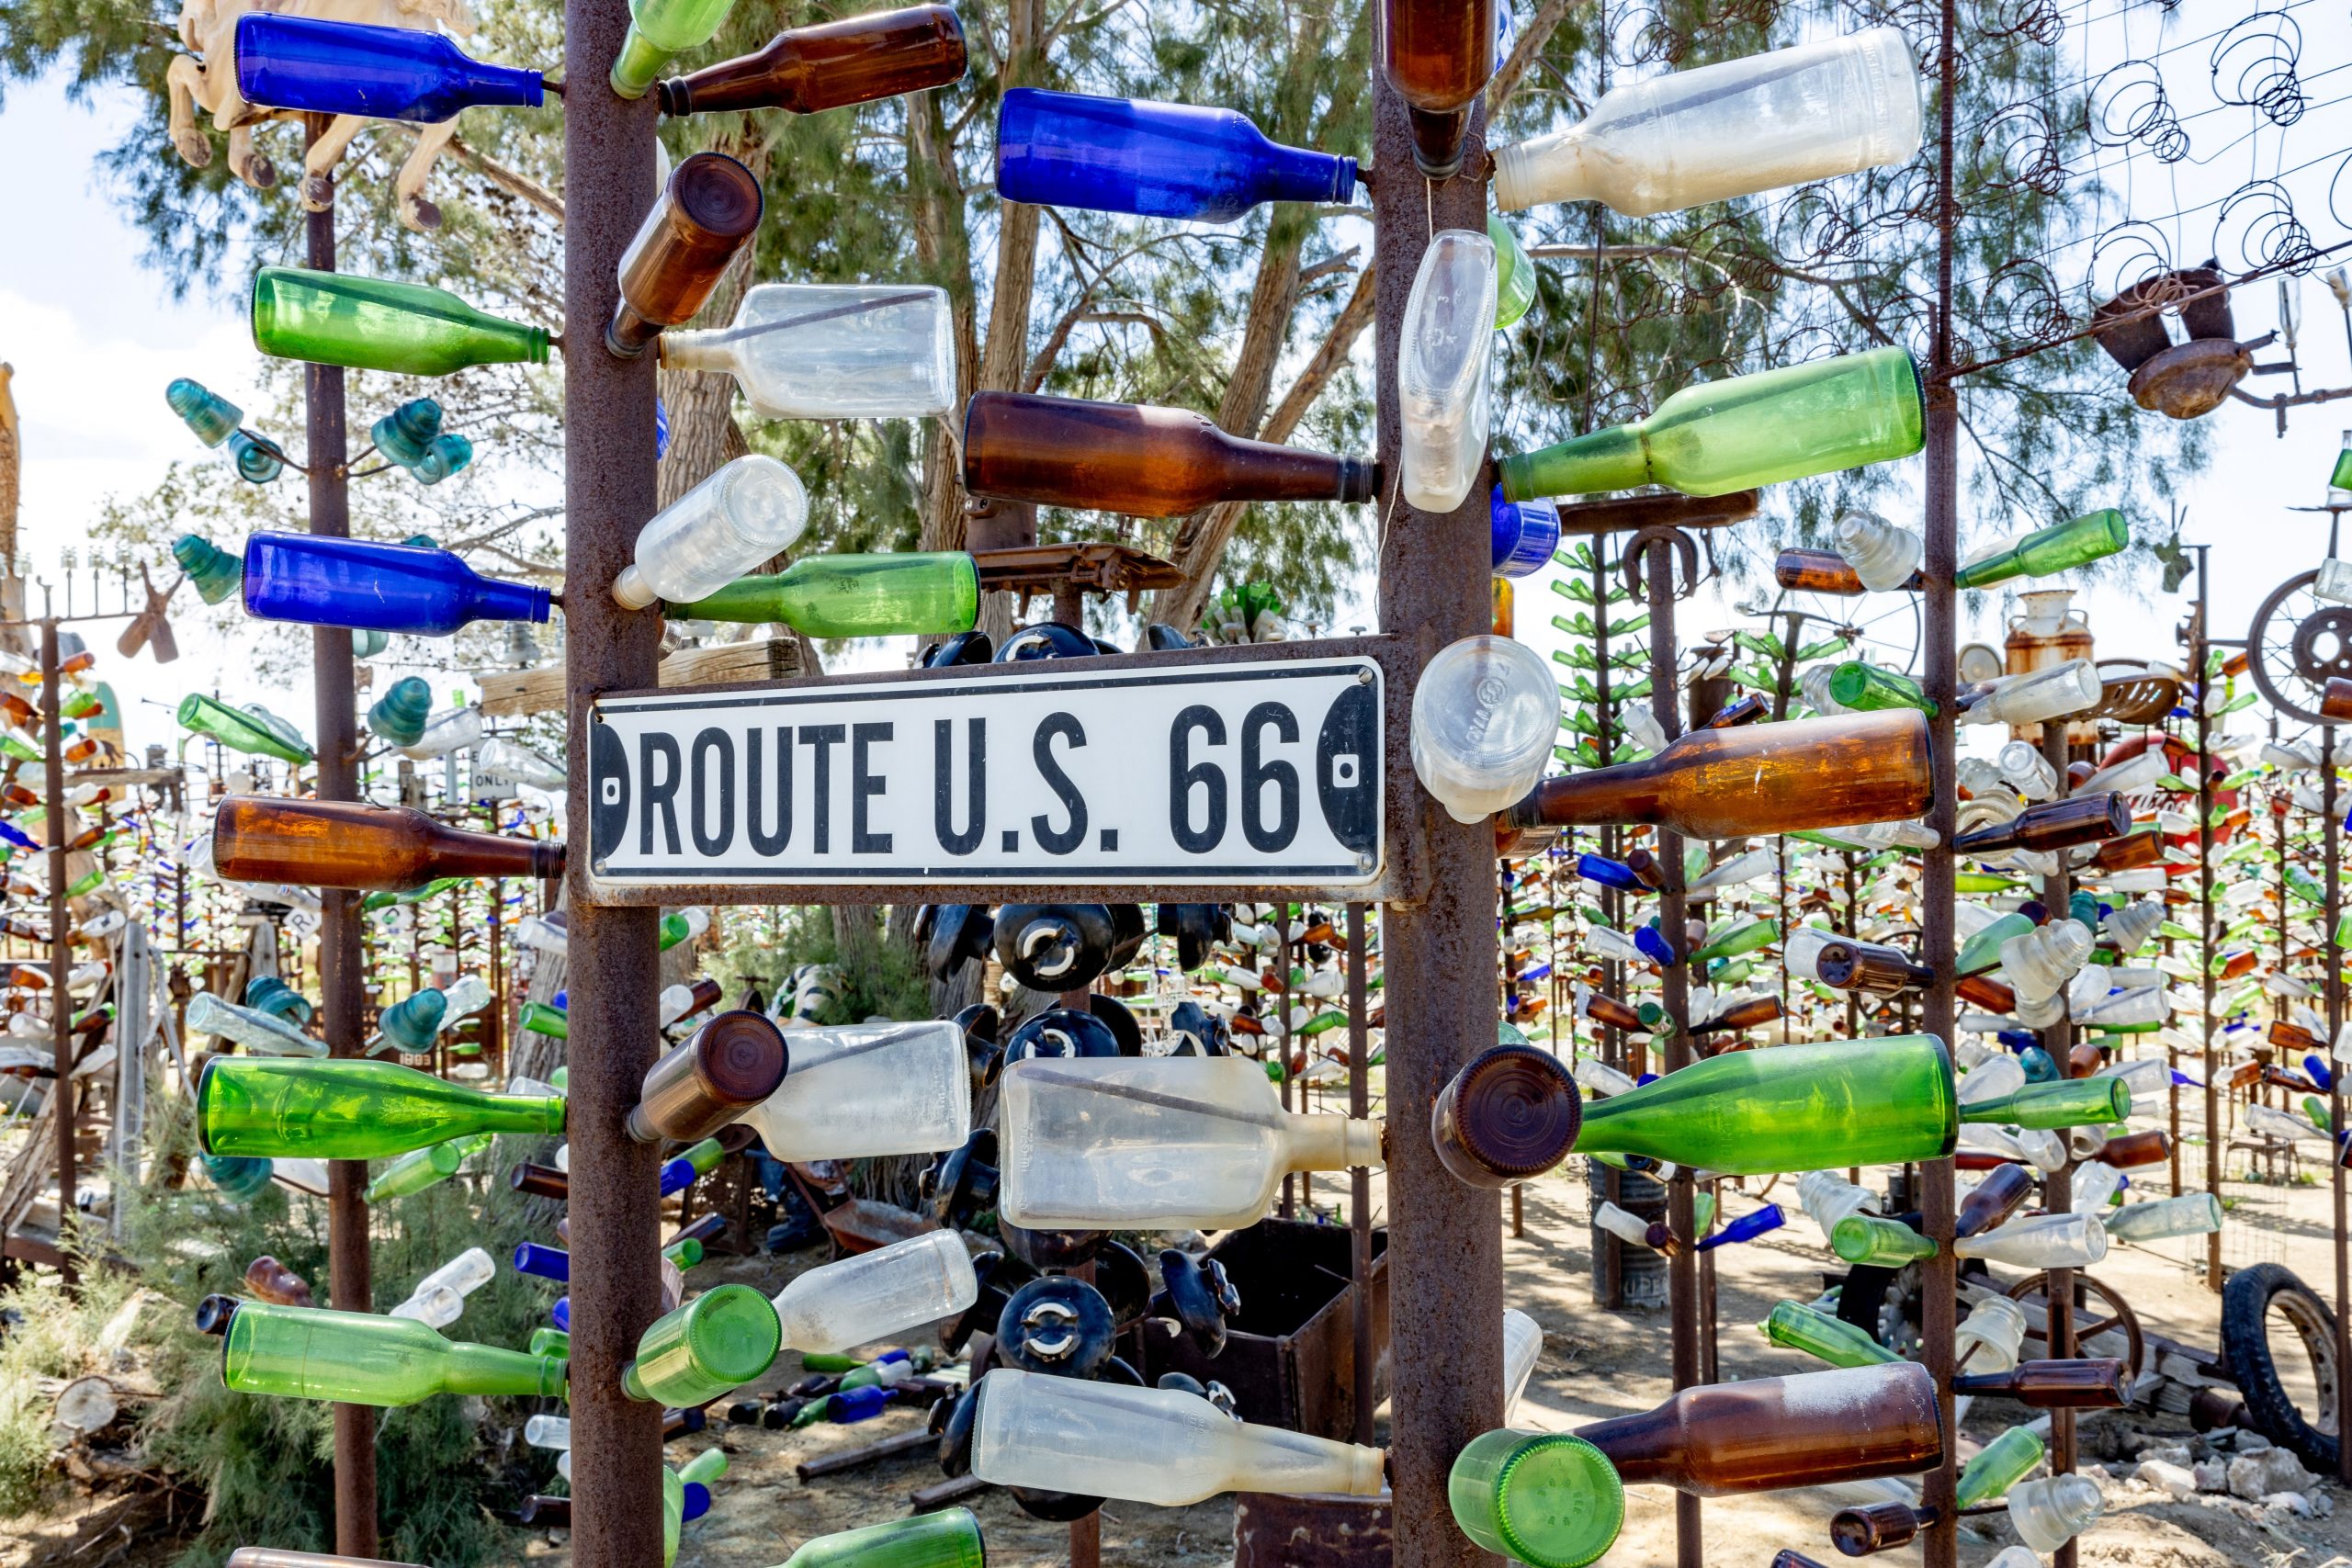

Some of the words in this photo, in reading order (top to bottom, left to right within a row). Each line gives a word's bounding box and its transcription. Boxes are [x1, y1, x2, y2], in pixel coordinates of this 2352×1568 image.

[639, 721, 894, 859] ROUTE
[933, 711, 1119, 857] U.S.
[1169, 700, 1301, 855] 66
